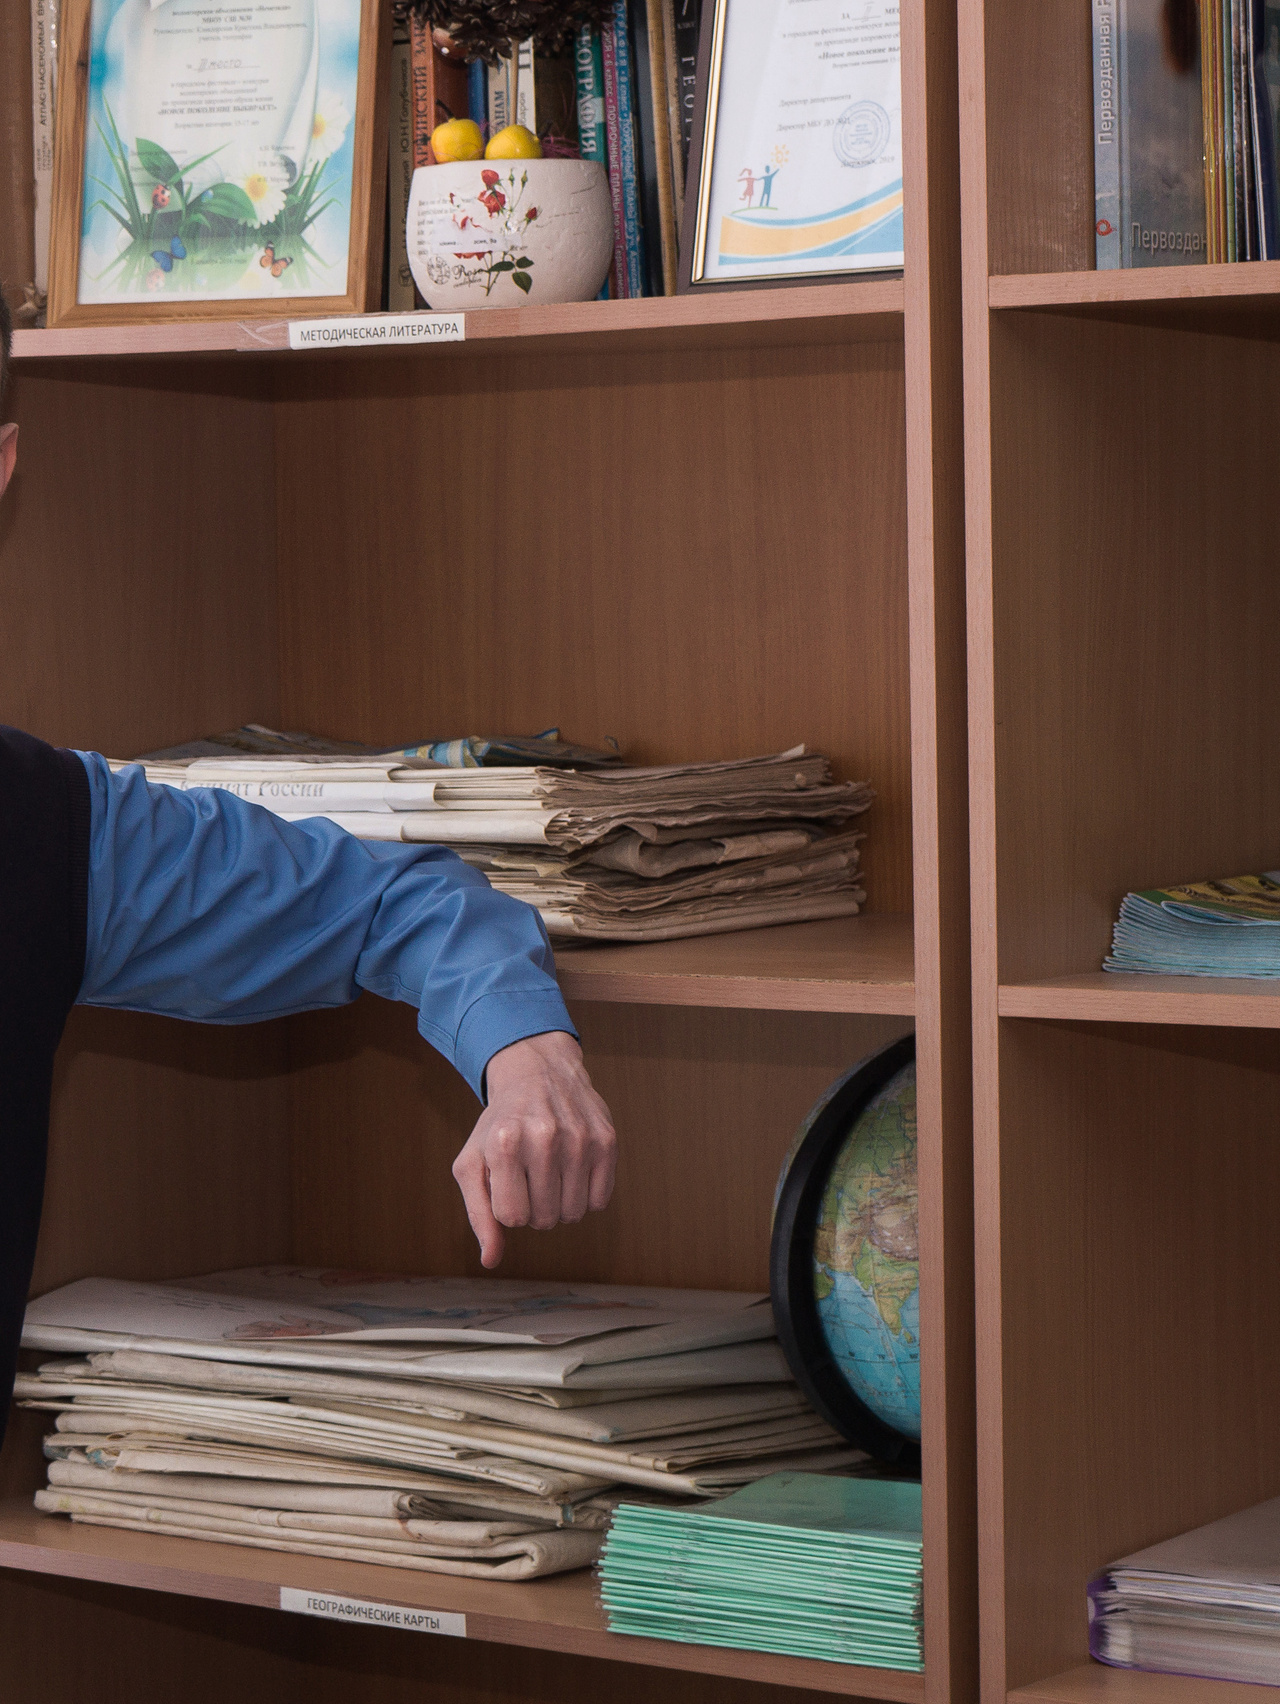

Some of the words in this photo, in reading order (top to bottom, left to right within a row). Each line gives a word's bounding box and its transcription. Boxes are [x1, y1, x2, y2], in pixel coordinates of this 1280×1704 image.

[1097, 16, 1115, 145] Первозданная
[607, 105, 620, 171] ПОУРОЧНЫЕ
[611, 173, 622, 211] ПЛАНЫ
[1131, 221, 1207, 255] Первоздан
[300, 326, 386, 342] МЕТОДИЧЕСКАЯ
[388, 322, 459, 338] ЛИТЕРАТУРА
[258, 780, 325, 797] России
[307, 1597, 401, 1624] ГЕОГРАФИЧЕСКИЕ
[403, 1614, 440, 1630] КАРТЫ
